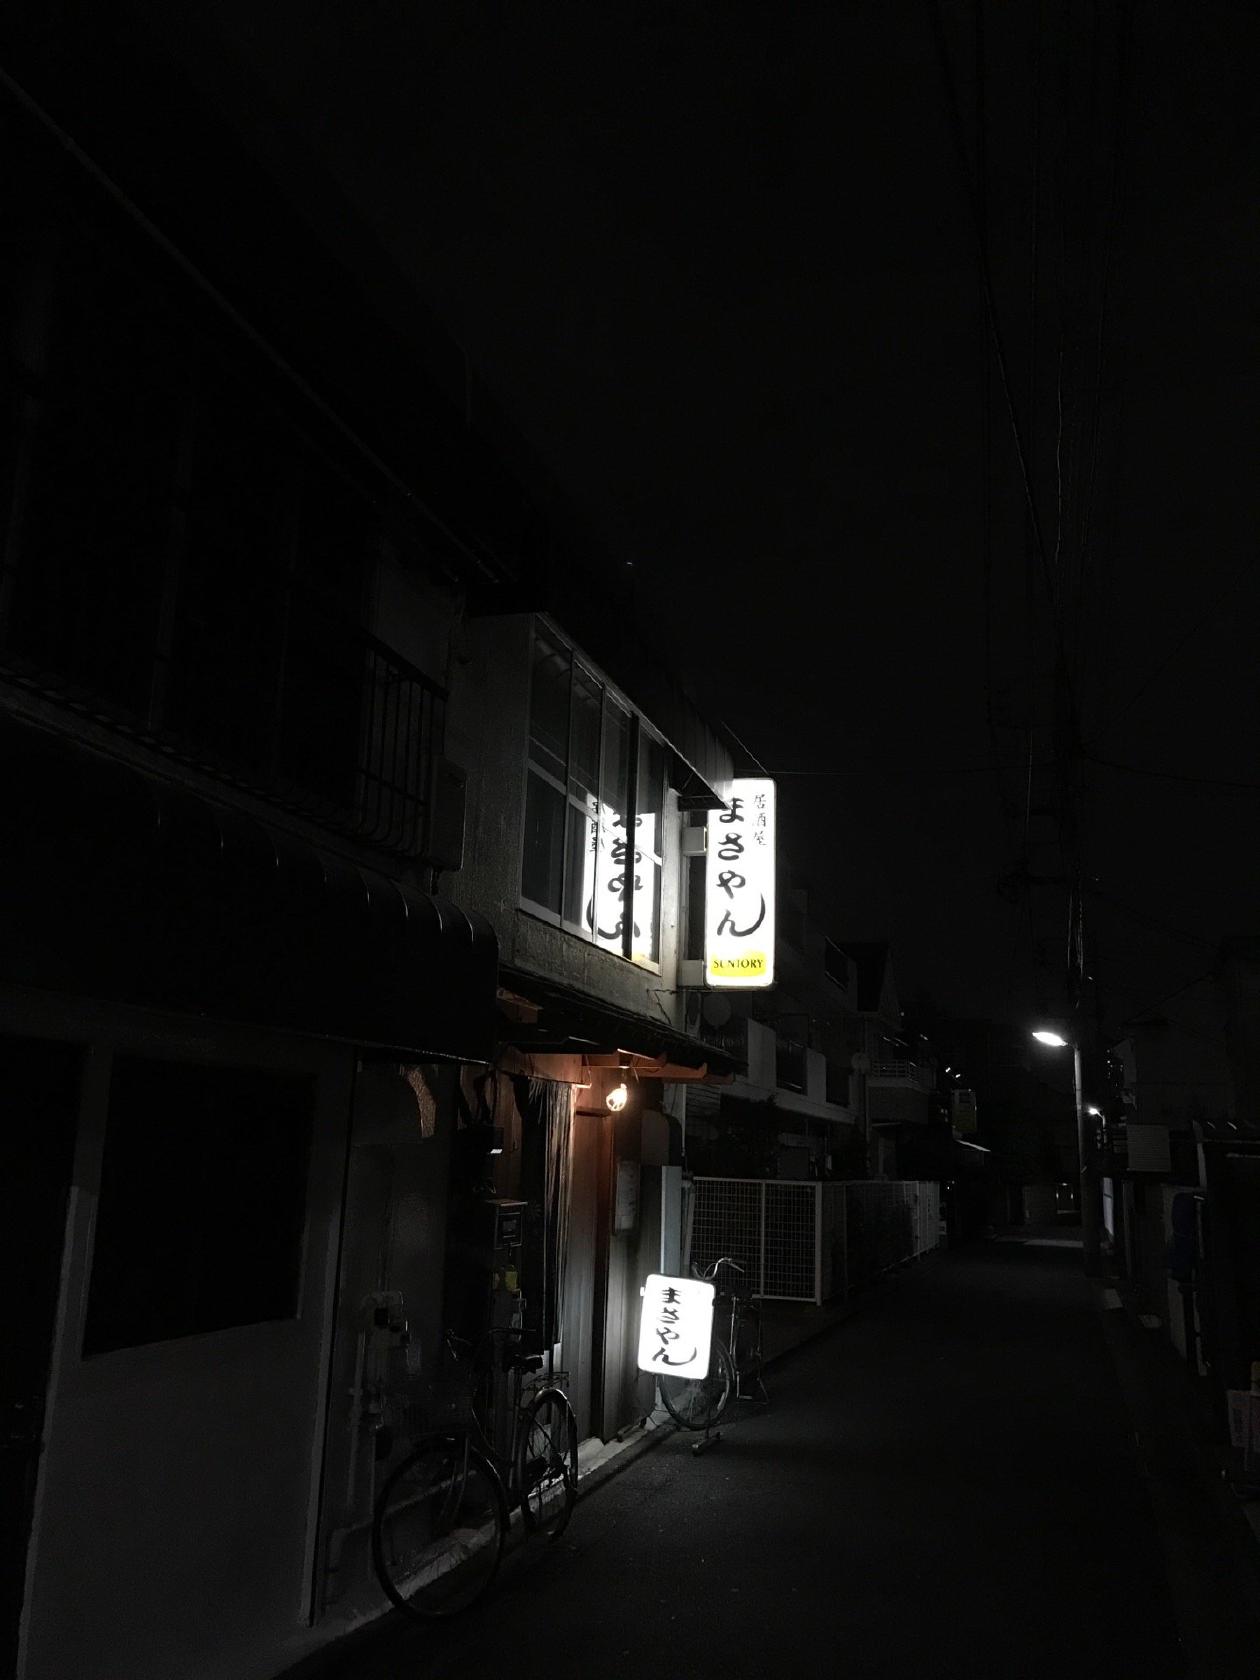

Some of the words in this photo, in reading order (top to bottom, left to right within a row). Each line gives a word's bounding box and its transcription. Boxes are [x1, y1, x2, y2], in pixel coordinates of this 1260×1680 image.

[716, 797, 766, 938] まさやん
[713, 958, 764, 970] SUNTORY
[652, 1286, 697, 1366] まさやん
